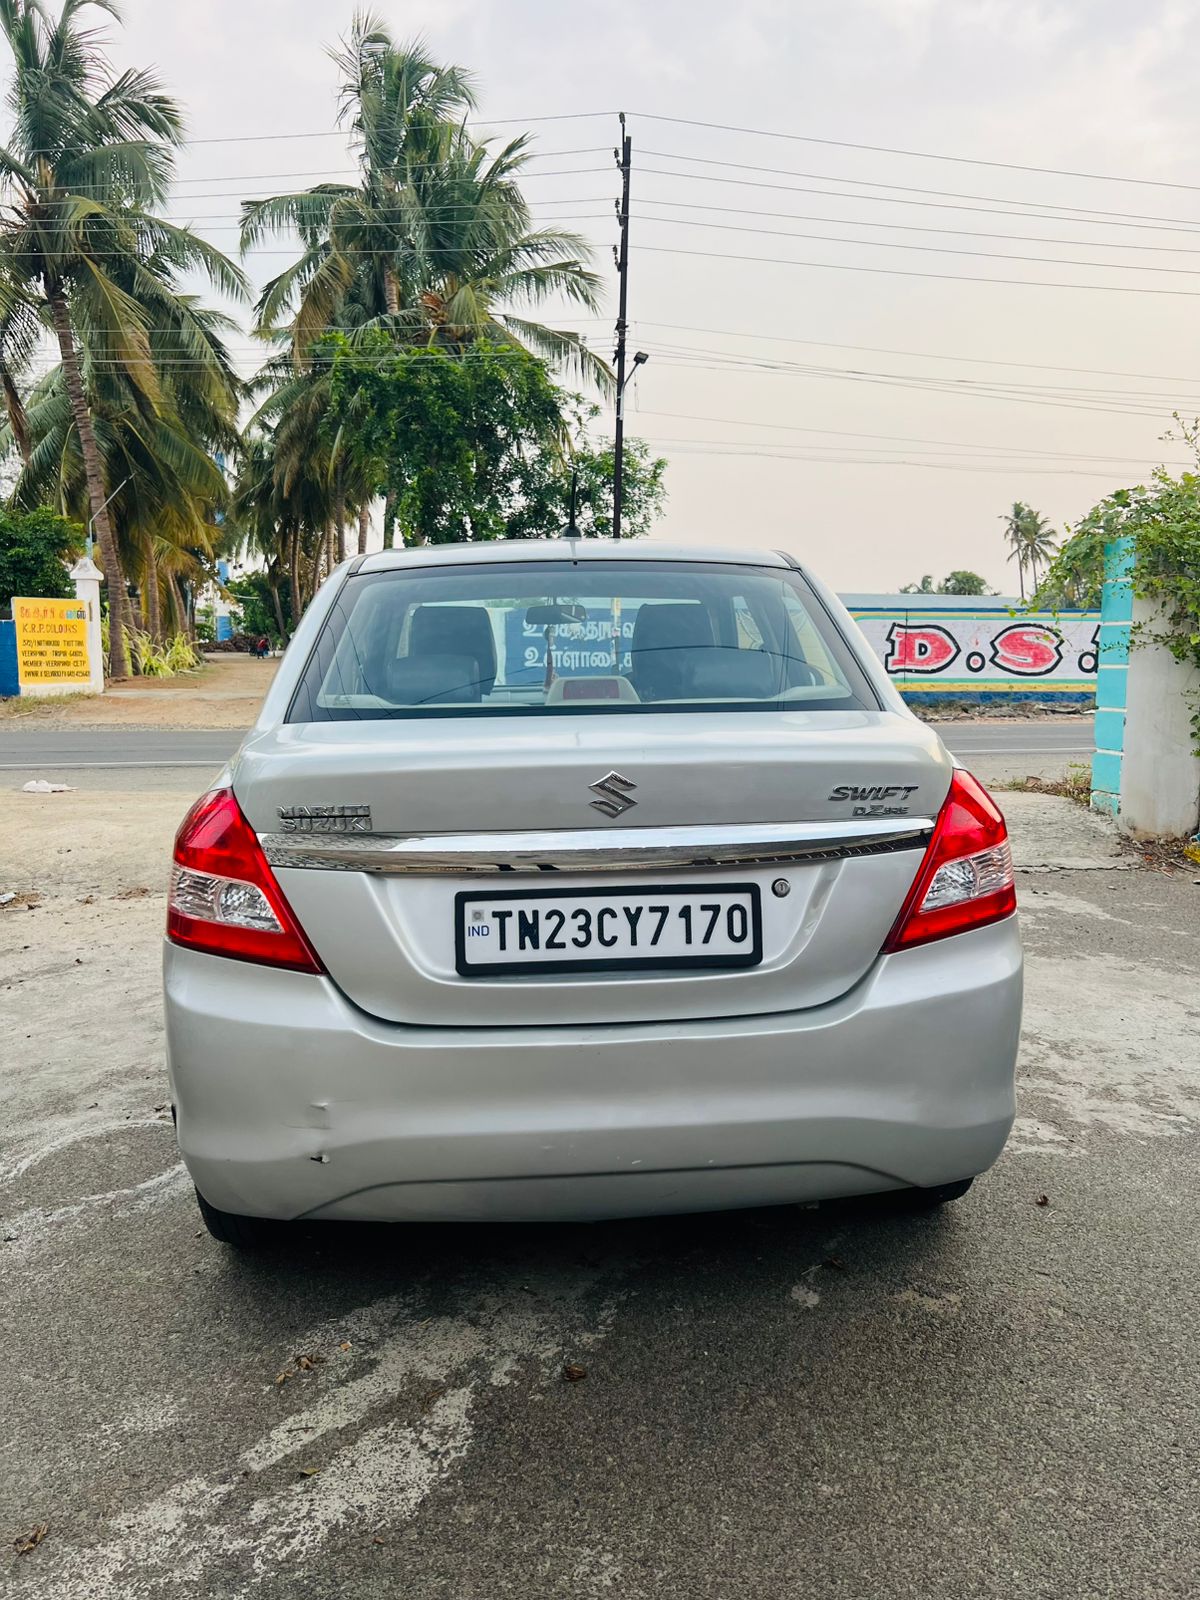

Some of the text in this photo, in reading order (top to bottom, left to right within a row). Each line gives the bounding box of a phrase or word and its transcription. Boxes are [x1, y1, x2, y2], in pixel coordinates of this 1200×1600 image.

[827, 786, 919, 801] SWIFT
[278, 805, 370, 819] MARUTI
[279, 818, 373, 832] SUZUKI
[467, 903, 748, 951] IND TN23CY7170
